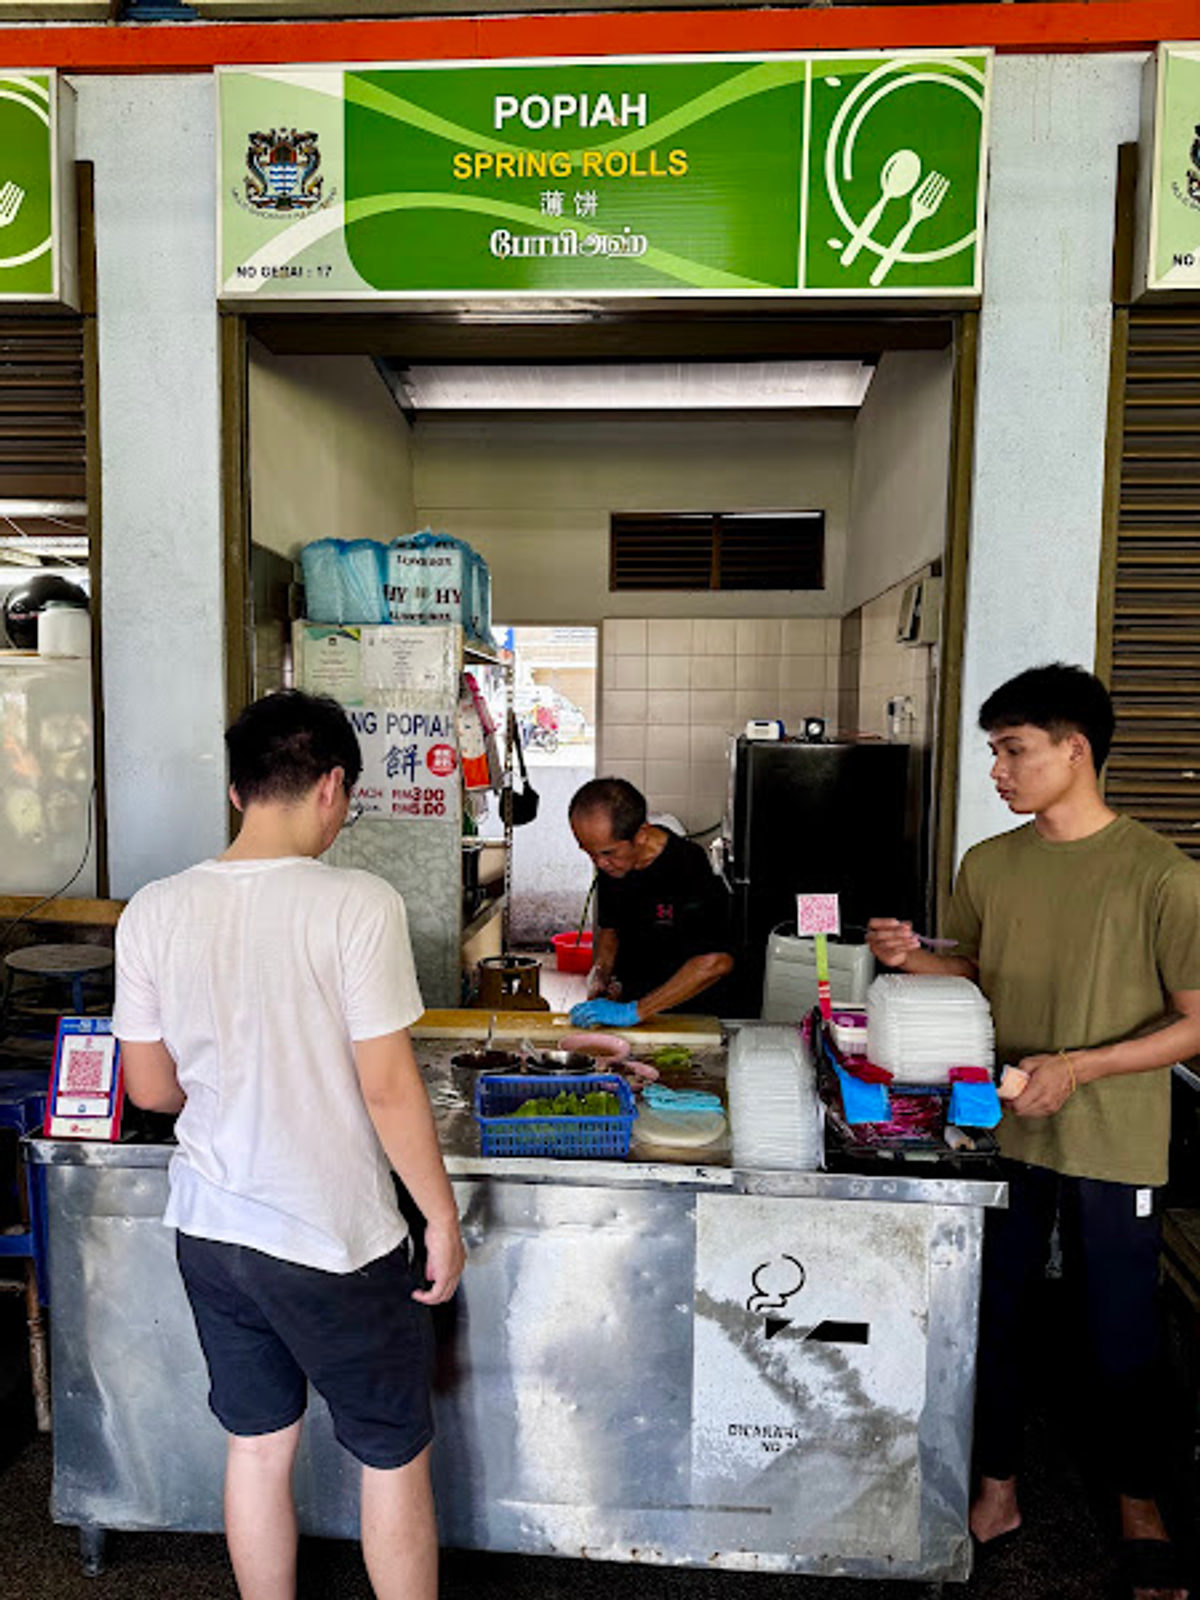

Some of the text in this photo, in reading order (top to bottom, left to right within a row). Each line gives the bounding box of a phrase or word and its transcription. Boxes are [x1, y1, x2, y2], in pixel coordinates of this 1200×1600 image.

[493, 93, 647, 130] POPIAH
[453, 149, 688, 179] SPRING ROLLS
[236, 265, 257, 278] NO
[436, 588, 462, 604] HY
